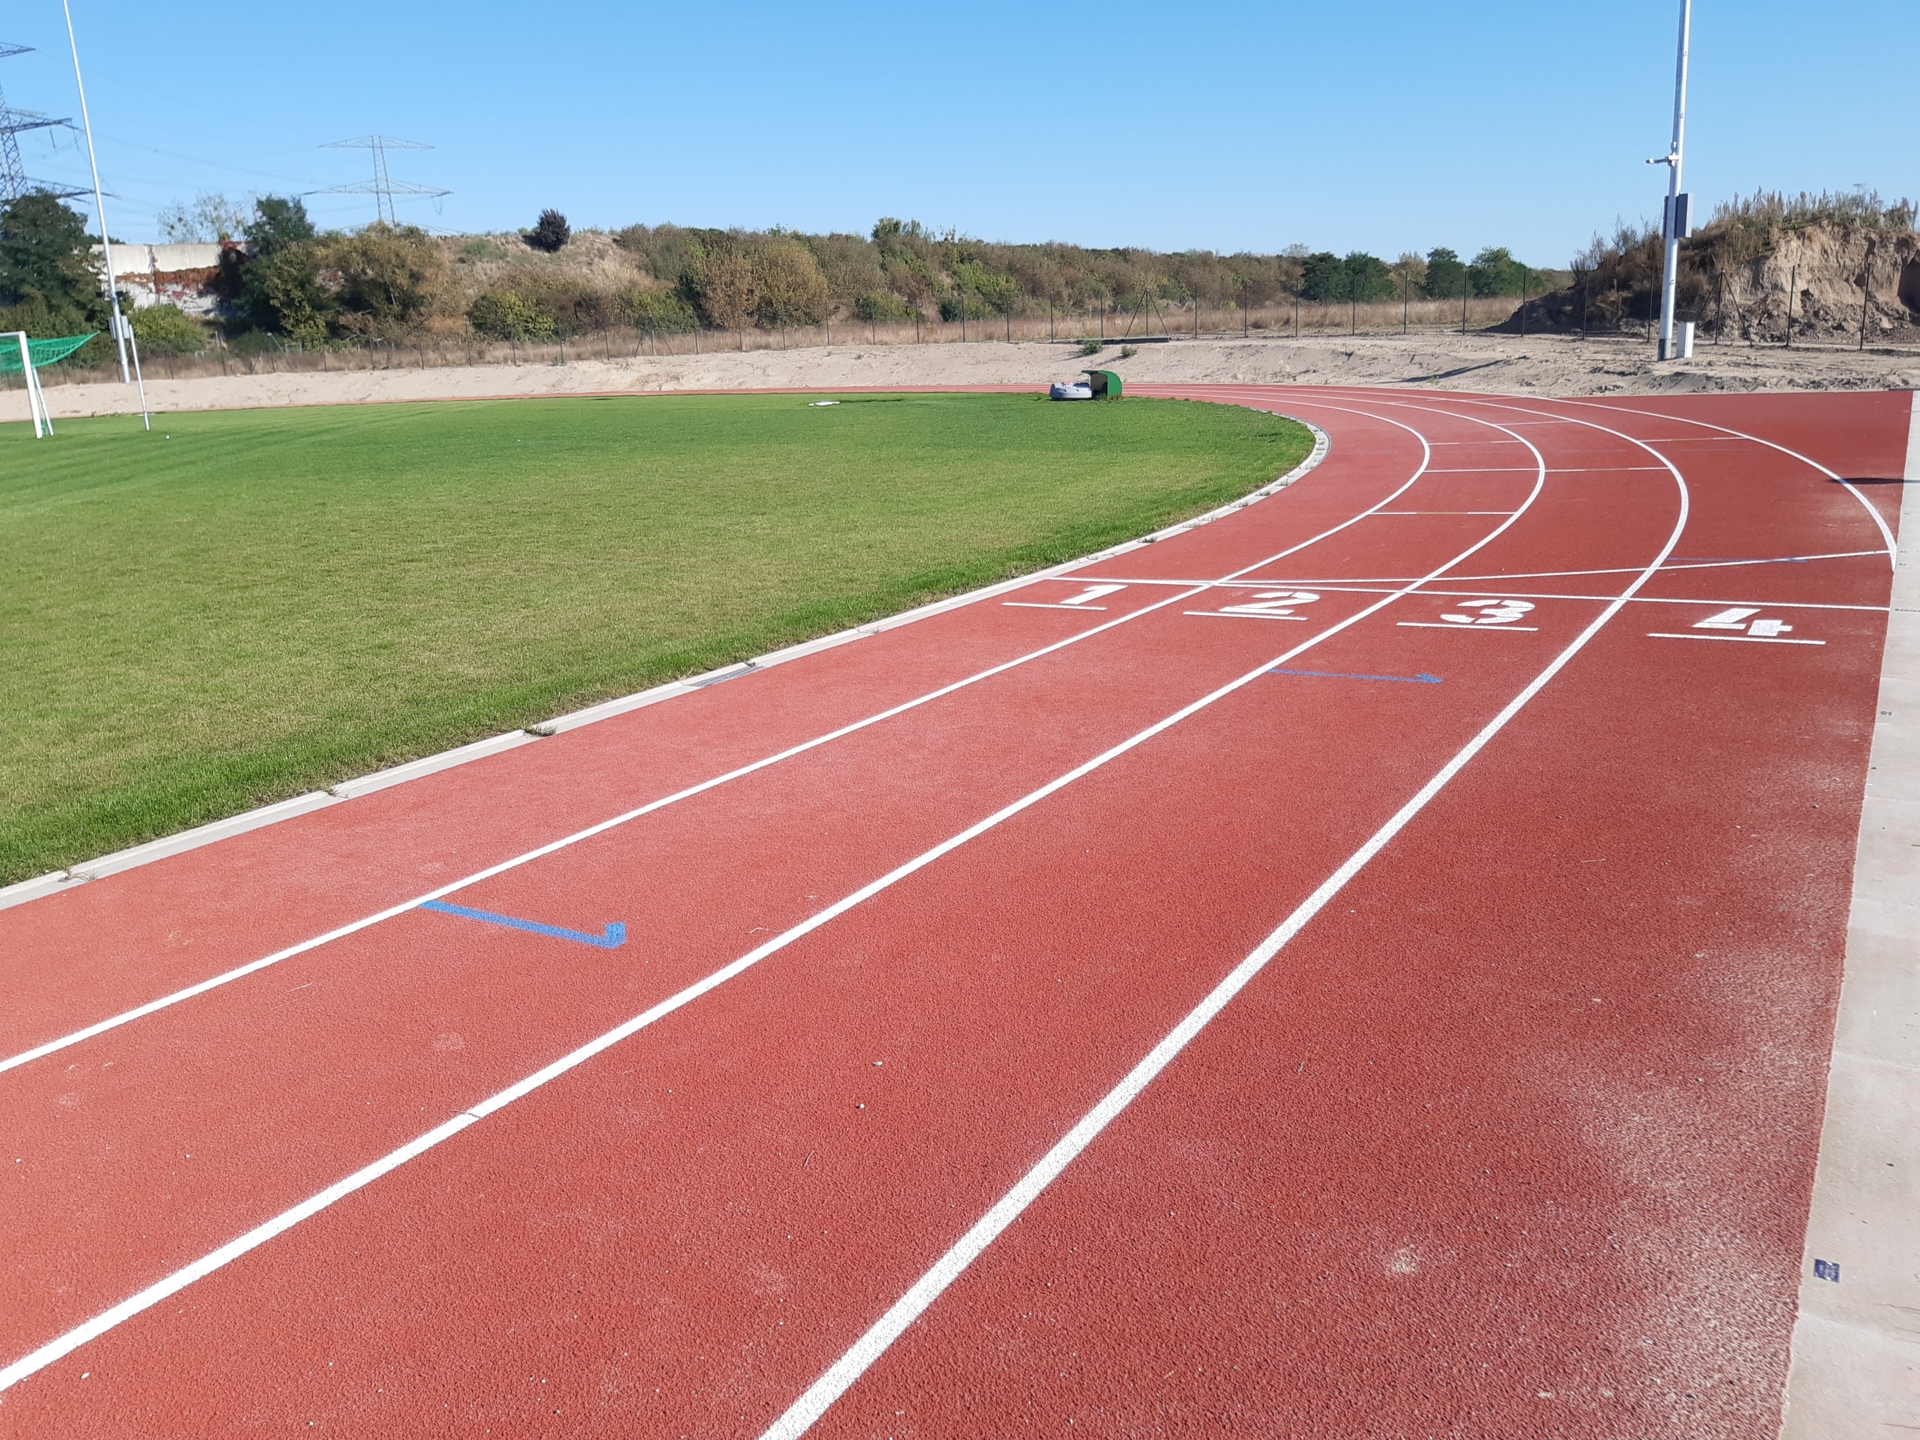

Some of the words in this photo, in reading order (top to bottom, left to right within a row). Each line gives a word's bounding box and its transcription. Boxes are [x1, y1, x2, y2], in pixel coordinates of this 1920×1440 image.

[1059, 584, 1129, 605] 1
[1218, 591, 1321, 616] 2
[1440, 599, 1536, 624] 3
[1691, 607, 1793, 637] 4
